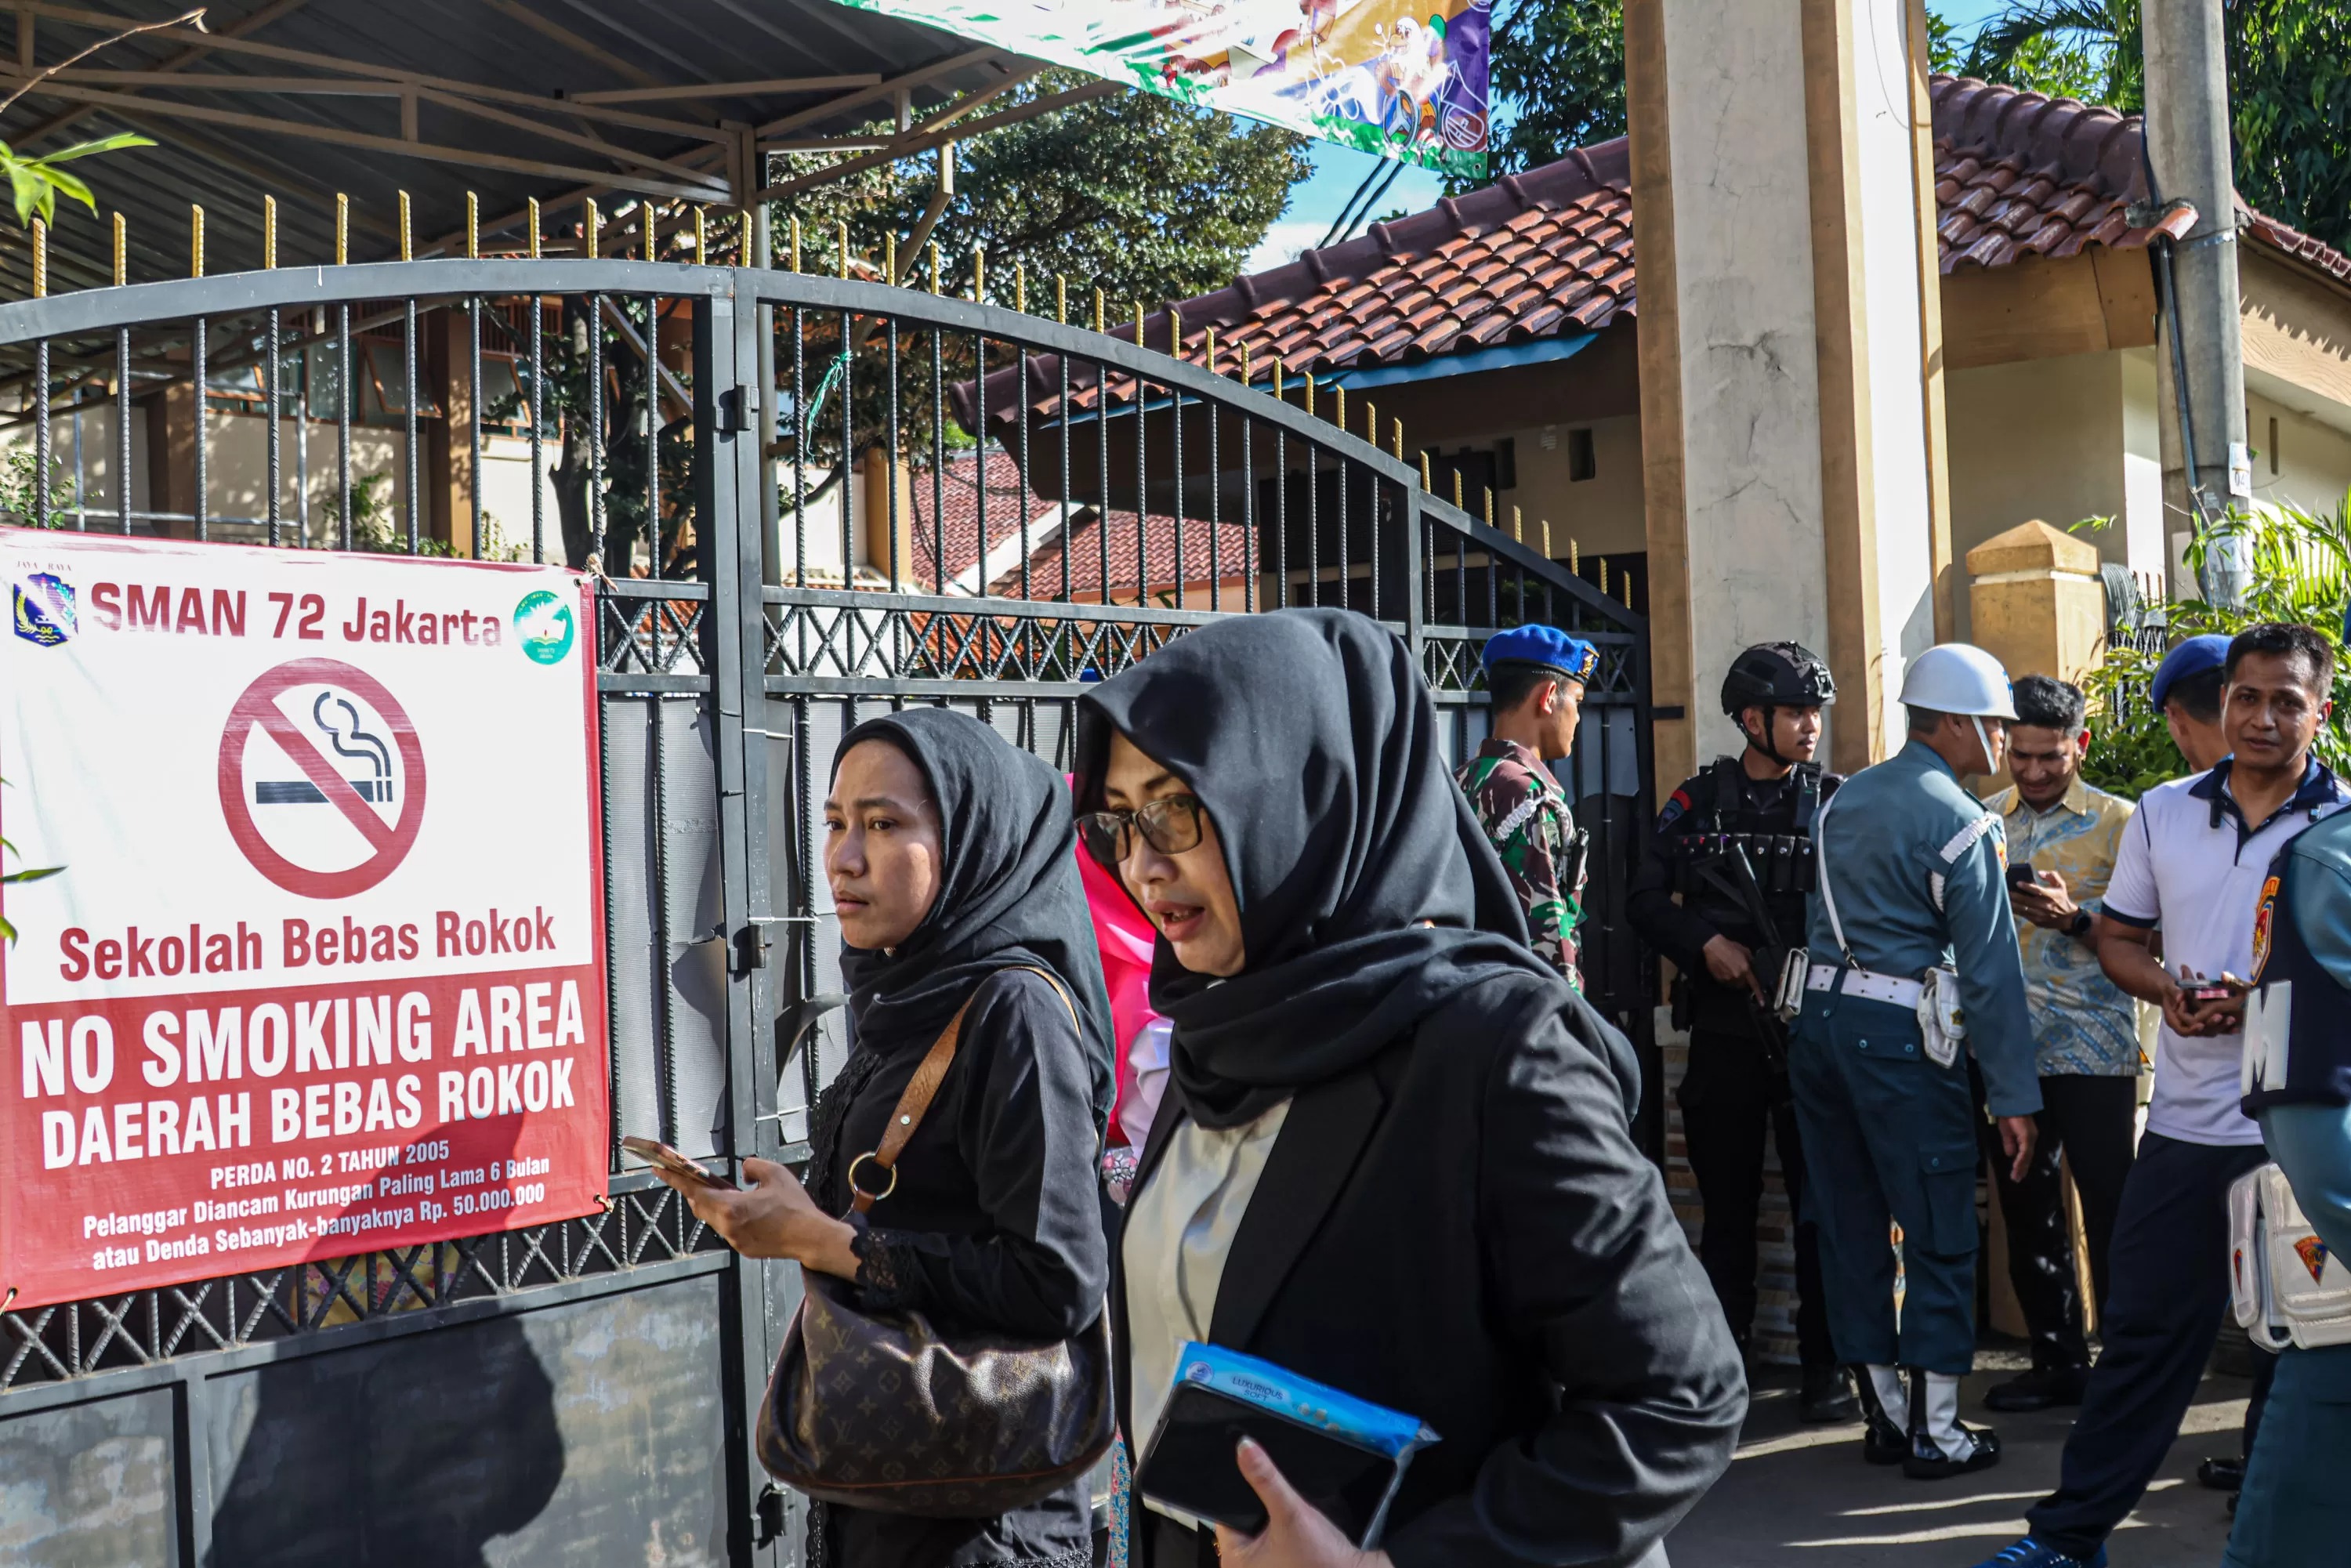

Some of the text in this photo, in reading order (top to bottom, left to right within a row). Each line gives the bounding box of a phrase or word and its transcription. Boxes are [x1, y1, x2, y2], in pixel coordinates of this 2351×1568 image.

[48, 563, 72, 571] RAYA
[91, 582, 502, 646] SMAN 72 Jakarta
[60, 905, 556, 983] Sekolah Bebas Rokok
[21, 977, 586, 1099] NO SMOKING AREA
[42, 1057, 576, 1170] DAERAH BEBAS ROKOK
[83, 1155, 550, 1239] Pelanggar Diancam Kurungan Paling Lama 6 Bulan
[210, 1139, 450, 1190] PERDA NO. 2 TAHUN 2005
[92, 1182, 545, 1271] atau Denda Sebanyak-banyaknya Rp. 50.000.000
[1232, 1375, 1284, 1401] LUXURIOUS
[1243, 1389, 1269, 1402] SOFT
